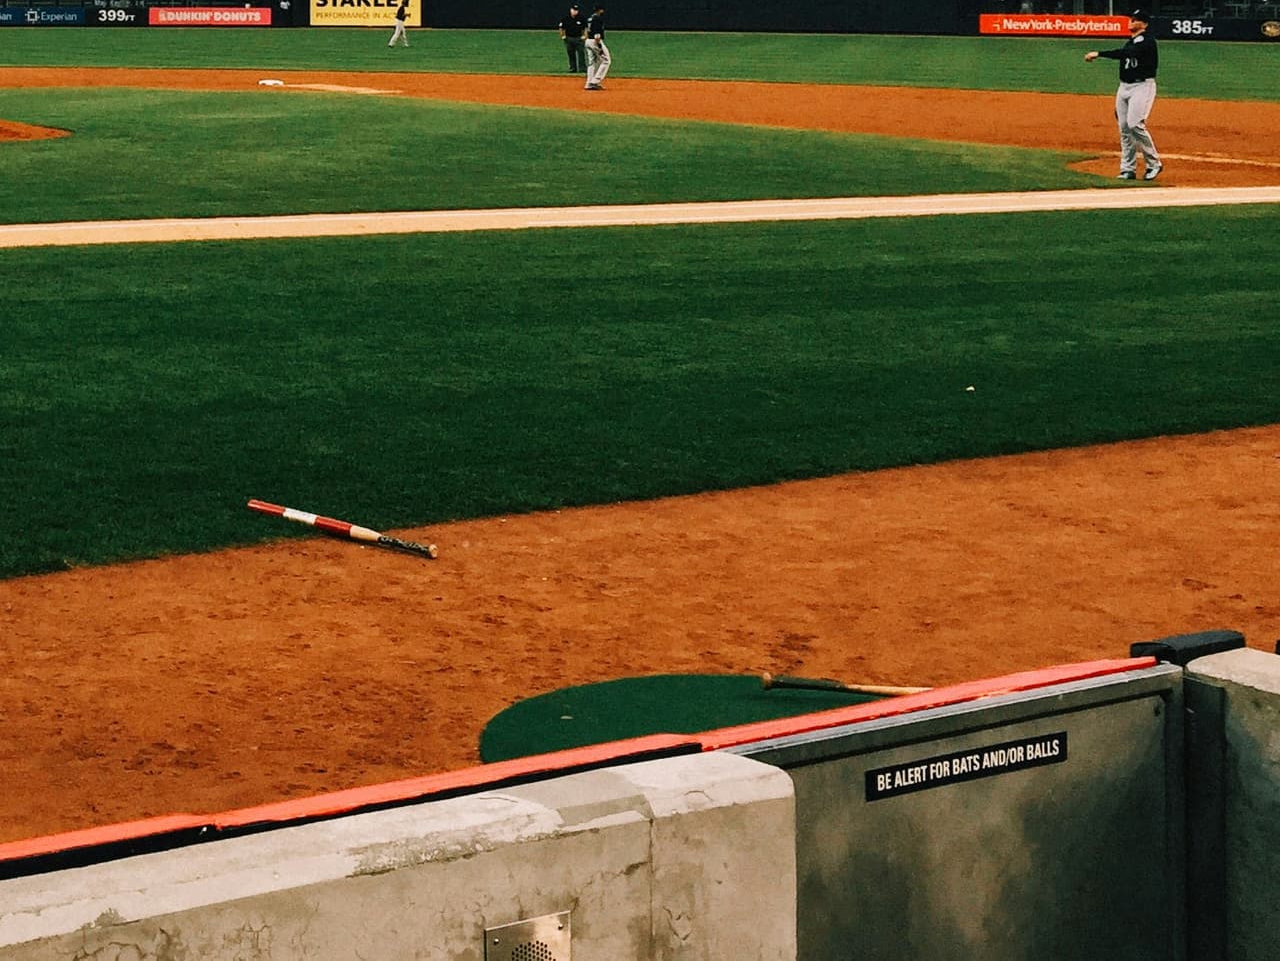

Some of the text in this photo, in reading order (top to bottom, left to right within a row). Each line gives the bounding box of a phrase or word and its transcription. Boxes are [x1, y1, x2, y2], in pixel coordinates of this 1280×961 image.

[41, 12, 77, 25] Experian
[167, 11, 261, 22] DUNKIN' DONUTS
[877, 739, 1060, 791] BE ALERT FOR BATS AND/OR BALLS
